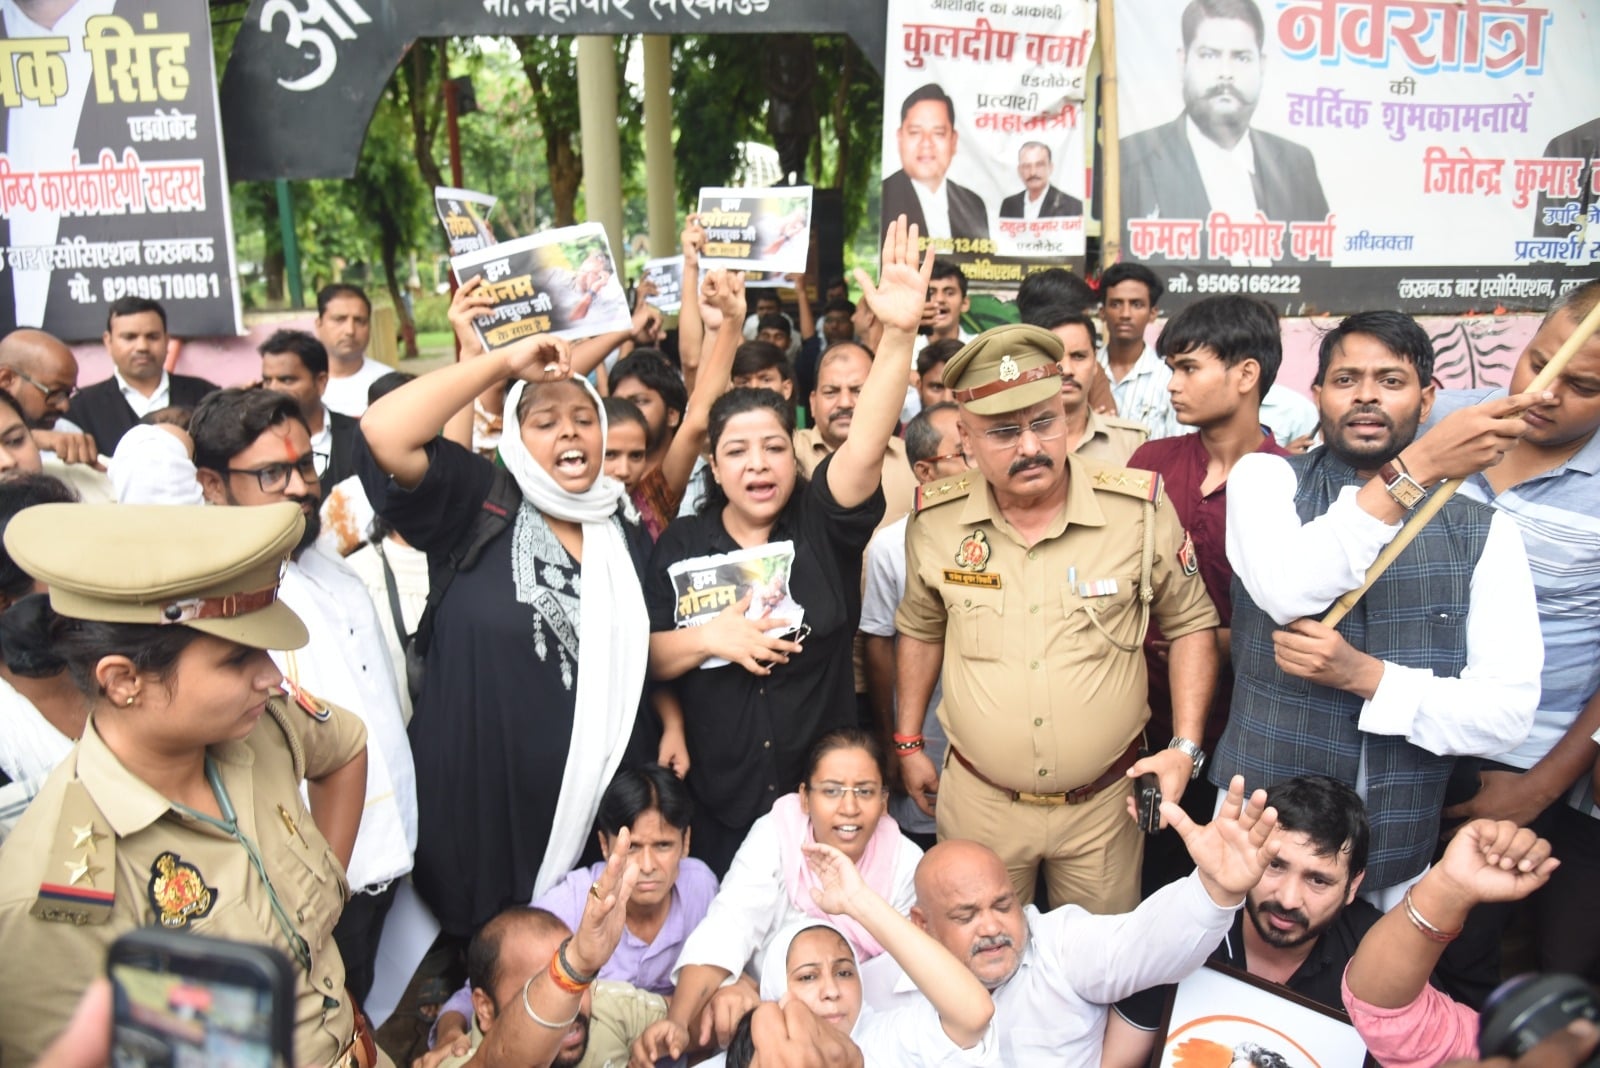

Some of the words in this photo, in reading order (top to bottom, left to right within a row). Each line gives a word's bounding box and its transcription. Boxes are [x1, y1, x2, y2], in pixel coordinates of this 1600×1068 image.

[83, 12, 191, 104] सिंह
[902, 18, 1019, 68] कुलदीप
[1024, 29, 1092, 68] वर्मा
[976, 91, 1039, 112] प्रत्याशी
[1389, 76, 1417, 97] की
[127, 108, 198, 143] एडवोकेट
[1286, 87, 1372, 128] हार्दिक
[1381, 91, 1536, 142] शुभकामनायें
[38, 152, 144, 213] कार्यकारिणी
[144, 164, 204, 209] सदस्य
[1423, 147, 1503, 196] जितेन्द्र
[1512, 157, 1584, 210] कुमार
[142, 237, 214, 265] लखनऊ
[1129, 218, 1201, 260] कमल
[1208, 211, 1285, 260] किशोर
[1290, 213, 1336, 260] वर्मा
[68, 271, 98, 304] मो.
[1168, 272, 1193, 294] मो.
[1196, 273, 1301, 295] 9506166222
[1399, 277, 1454, 299] लखनऊ
[1454, 278, 1480, 299] बार
[691, 569, 718, 590] हम
